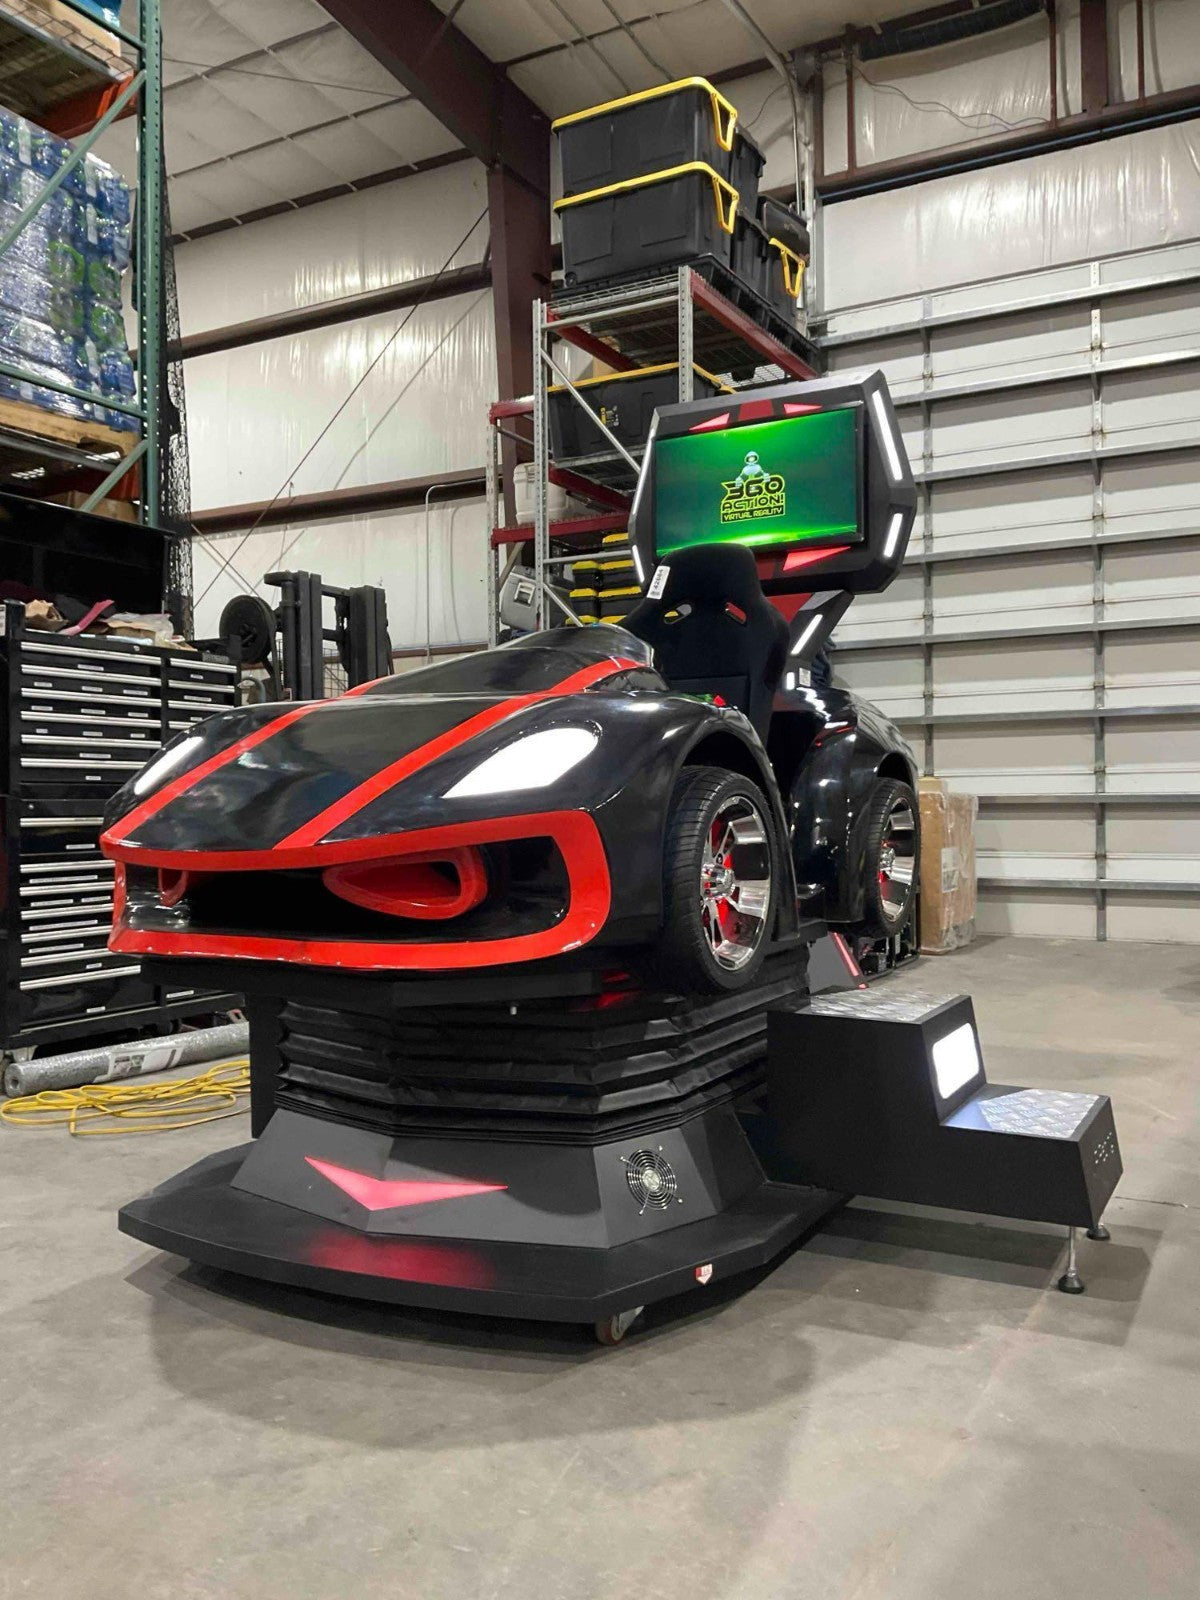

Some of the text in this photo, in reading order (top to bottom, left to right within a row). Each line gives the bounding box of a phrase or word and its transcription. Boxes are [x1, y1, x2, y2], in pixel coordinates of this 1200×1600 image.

[722, 475, 785, 502] 360
[722, 493, 784, 512] ACTION!
[724, 507, 782, 521] VIRTUAL REALITY
